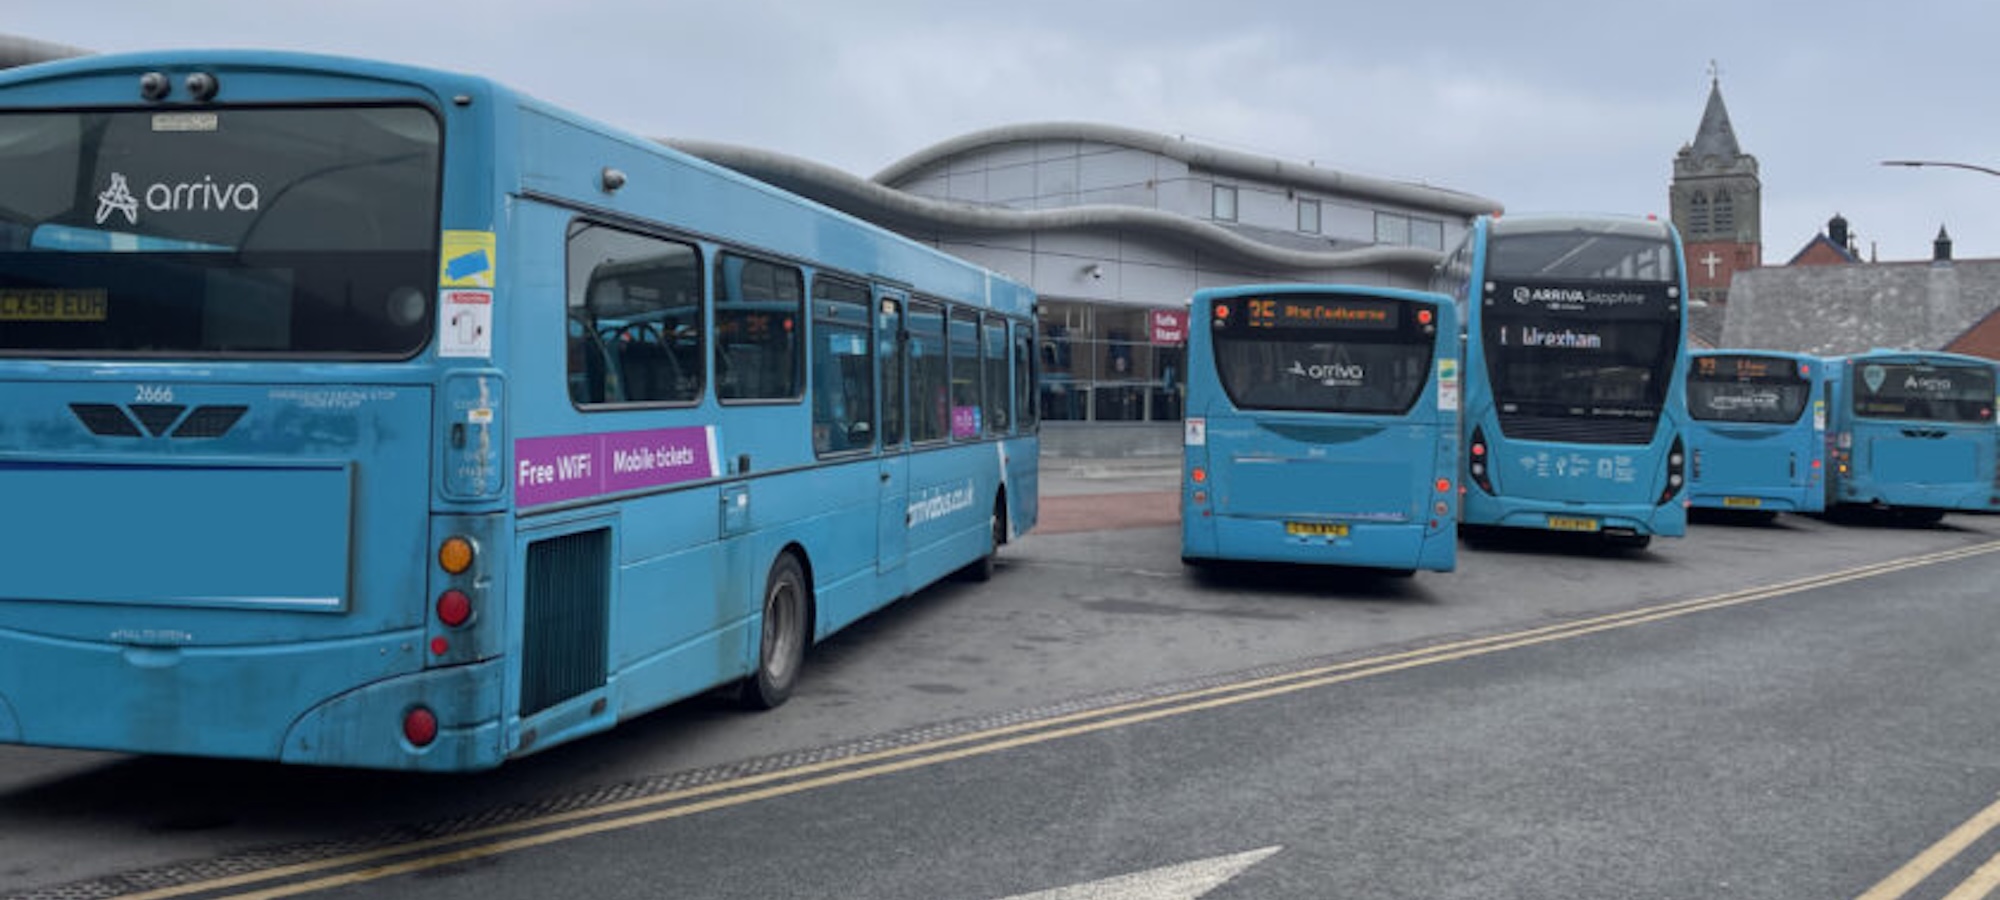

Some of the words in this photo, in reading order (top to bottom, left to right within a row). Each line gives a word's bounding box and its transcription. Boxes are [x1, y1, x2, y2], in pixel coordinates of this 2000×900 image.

[146, 175, 259, 211] arriva
[1532, 288, 1584, 301] ARRIVA
[1585, 290, 1646, 305] Sapphire
[1522, 327, 1602, 348] Wrexham
[1307, 362, 1364, 379] arriva
[135, 384, 173, 402] 2666
[519, 460, 554, 487] Free
[557, 454, 592, 482] WiFi
[613, 448, 654, 474] Mobile
[656, 446, 694, 468] tickets
